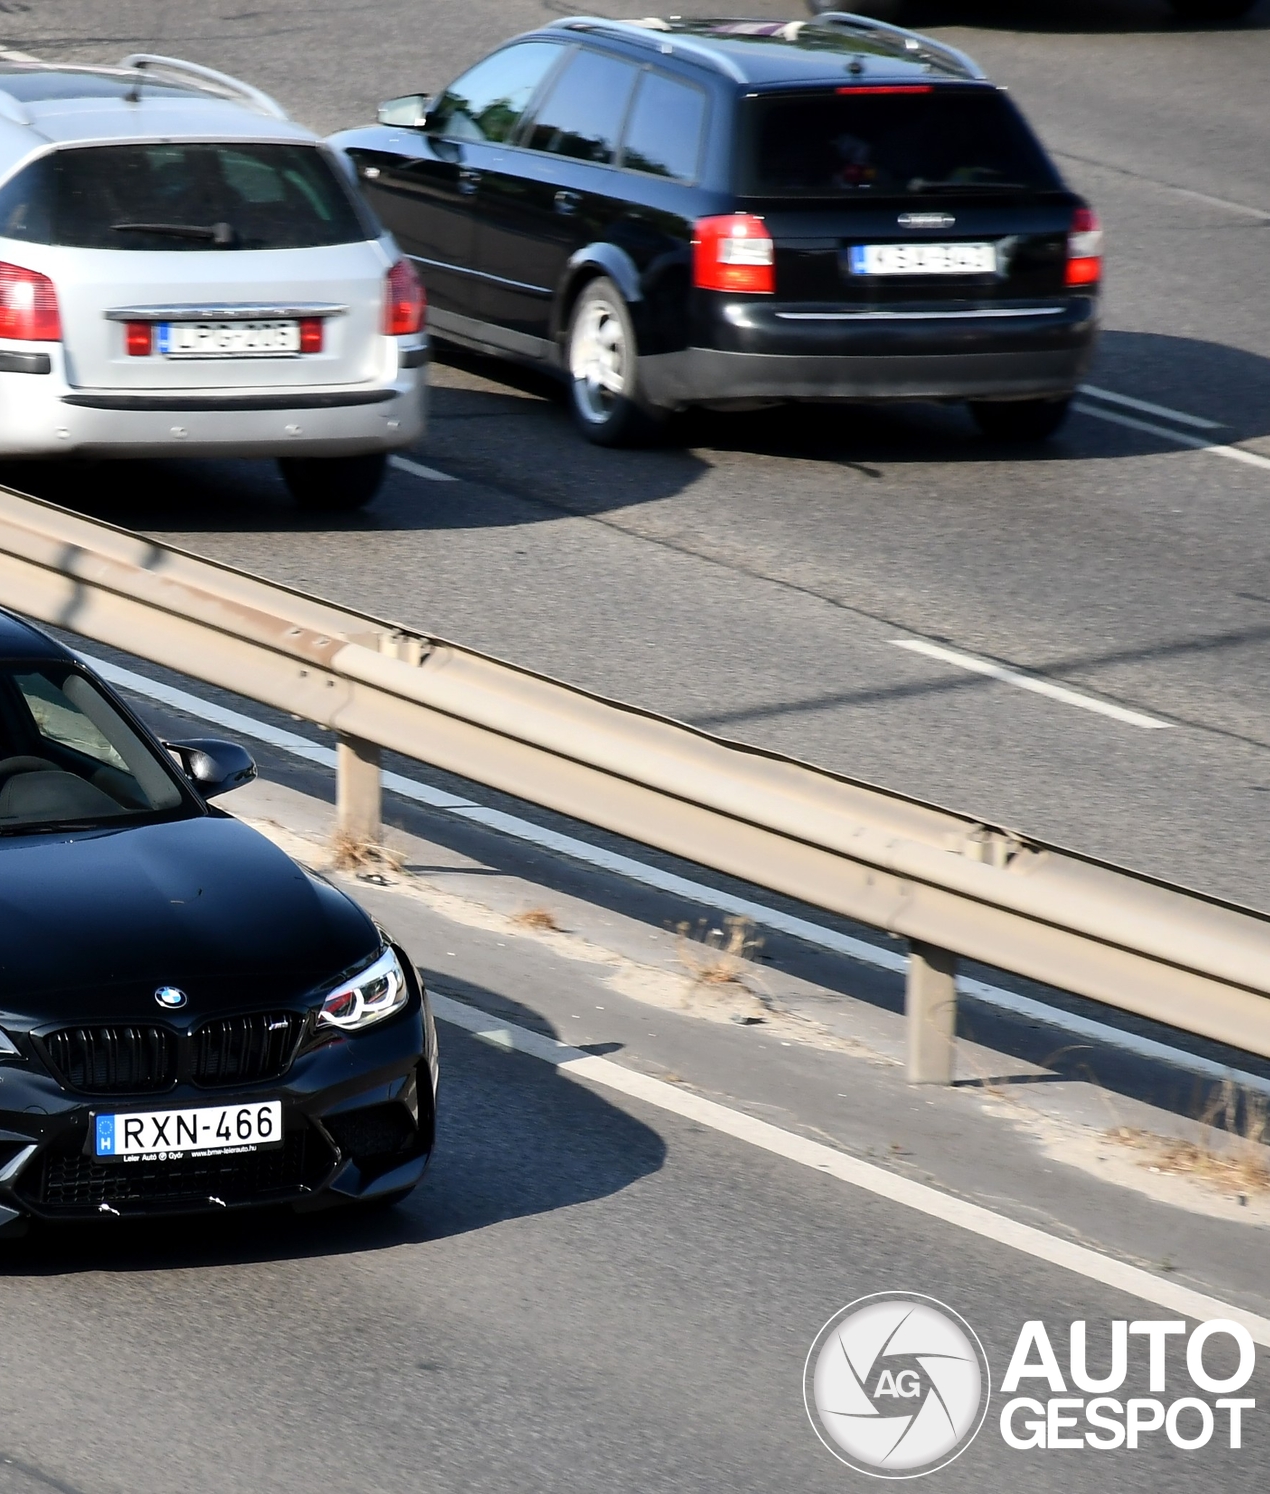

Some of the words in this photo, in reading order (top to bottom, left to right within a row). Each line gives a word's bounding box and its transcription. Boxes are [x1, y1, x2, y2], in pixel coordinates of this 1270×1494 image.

[124, 1106, 273, 1149] RXN-466
[100, 1137, 111, 1151] H
[123, 1154, 140, 1163] Leier
